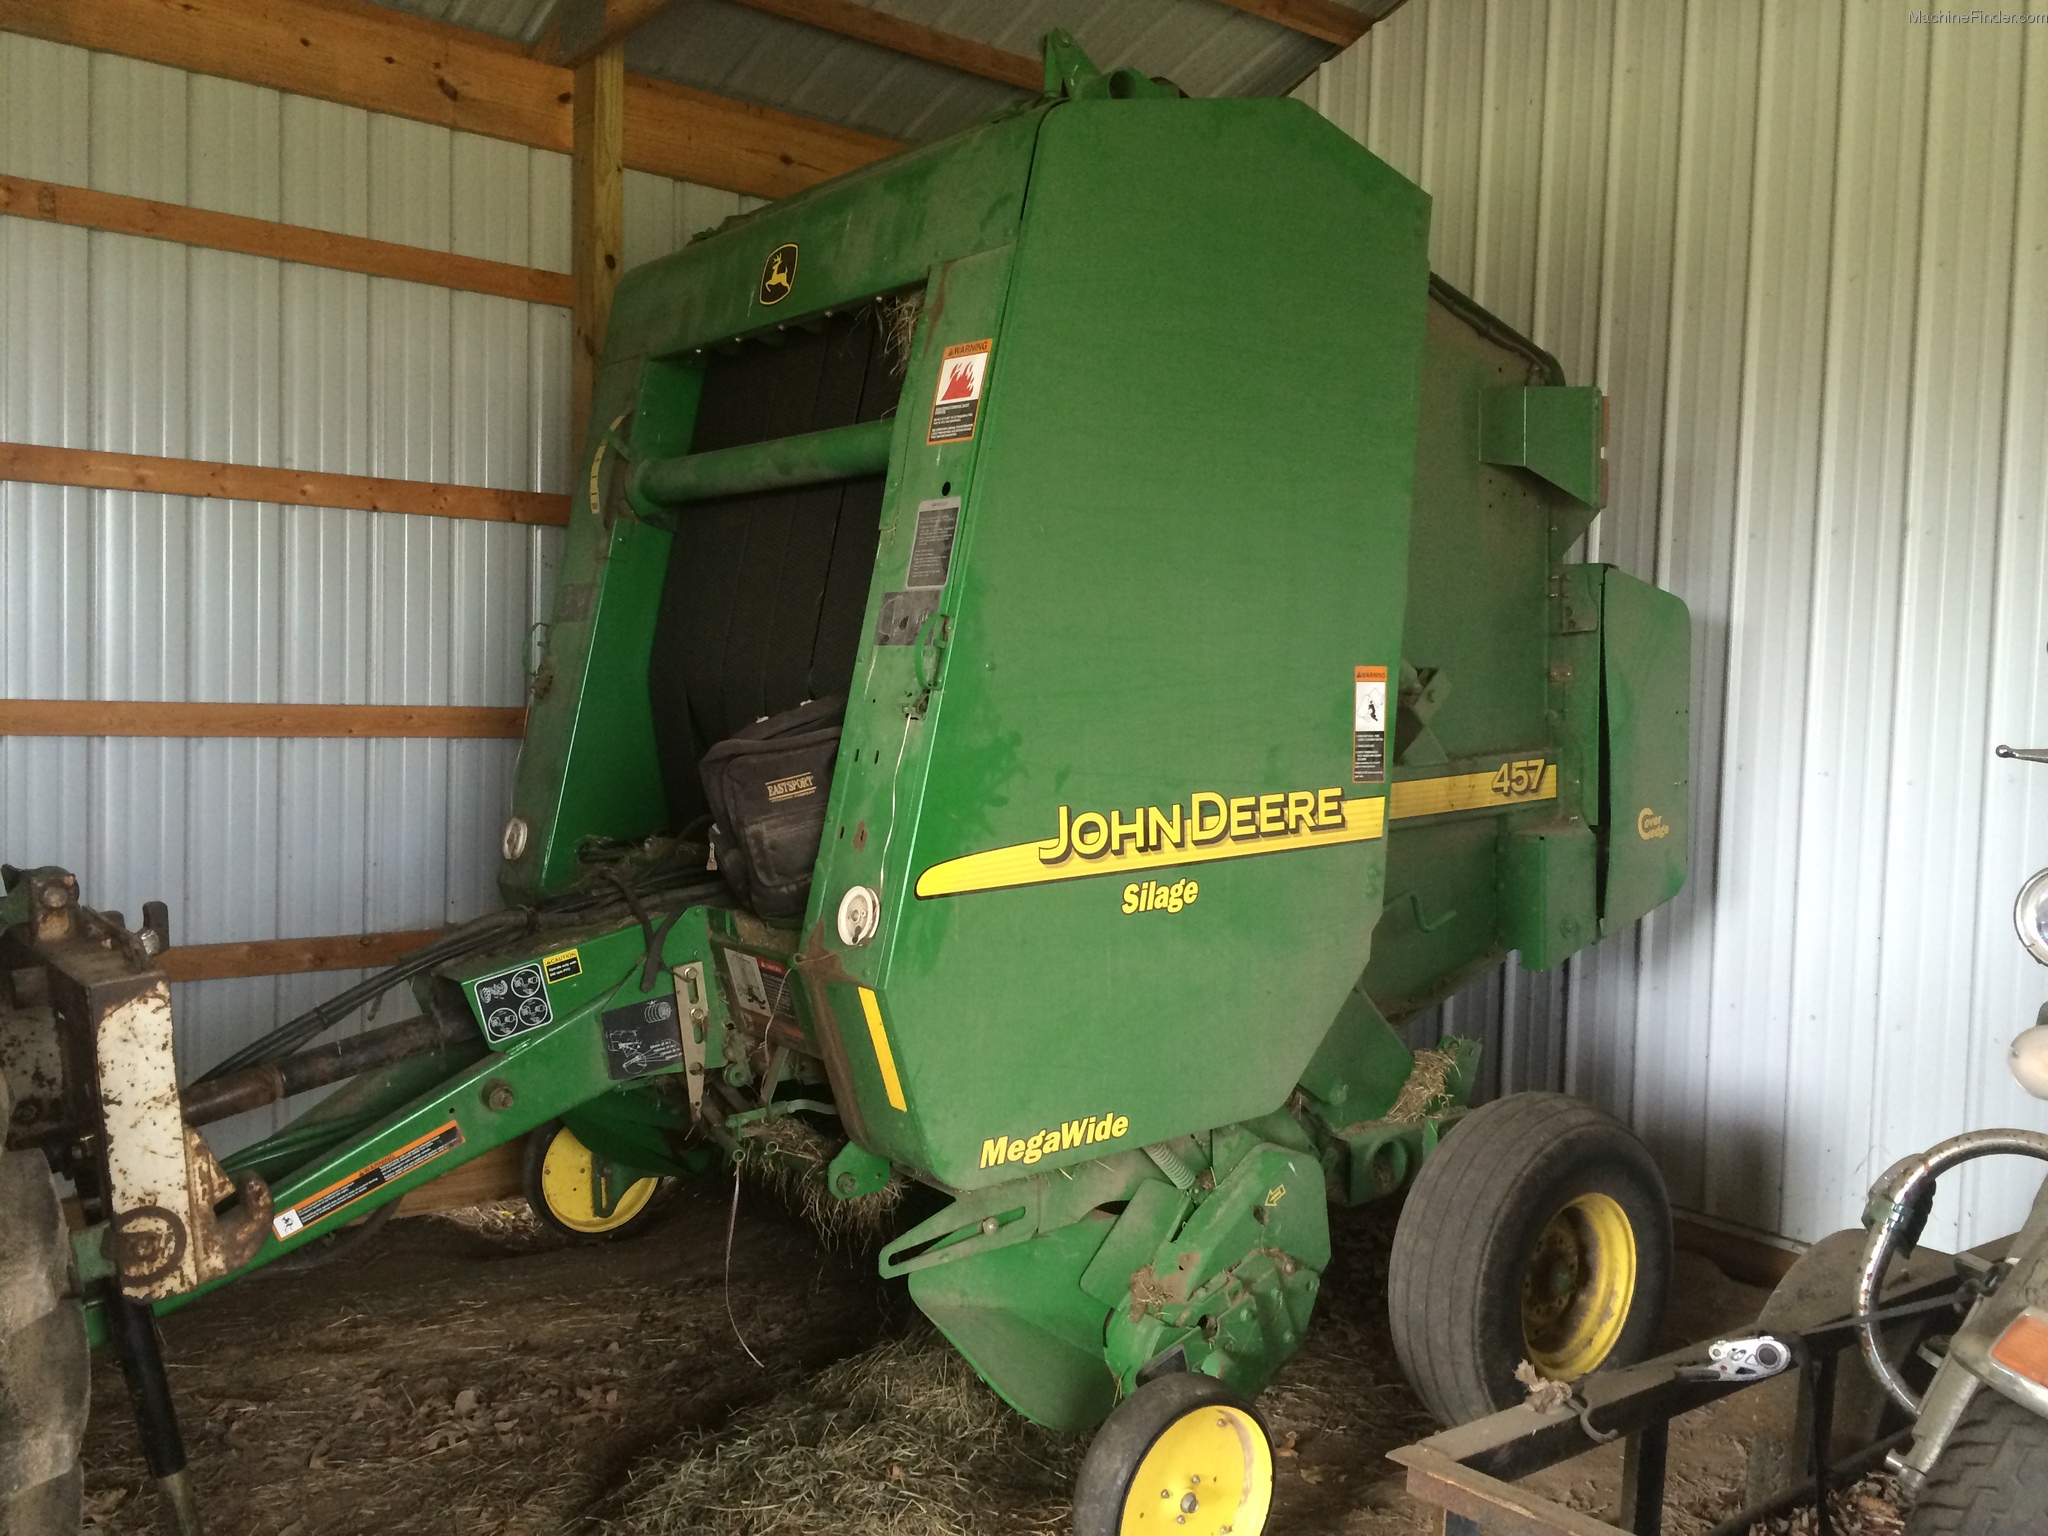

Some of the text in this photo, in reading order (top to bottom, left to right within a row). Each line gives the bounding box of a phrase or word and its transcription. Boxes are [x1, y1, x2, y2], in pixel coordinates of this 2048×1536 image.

[954, 341, 988, 355] WARNING
[767, 775, 814, 797] EASTSPORT
[1492, 758, 1546, 796] 457
[1039, 787, 1345, 863] JOHN DEERE
[1122, 877, 1199, 914] Silage
[550, 953, 576, 963] CAUTION
[979, 1112, 1129, 1169] MegaWide
[364, 1153, 396, 1174] WARNING
